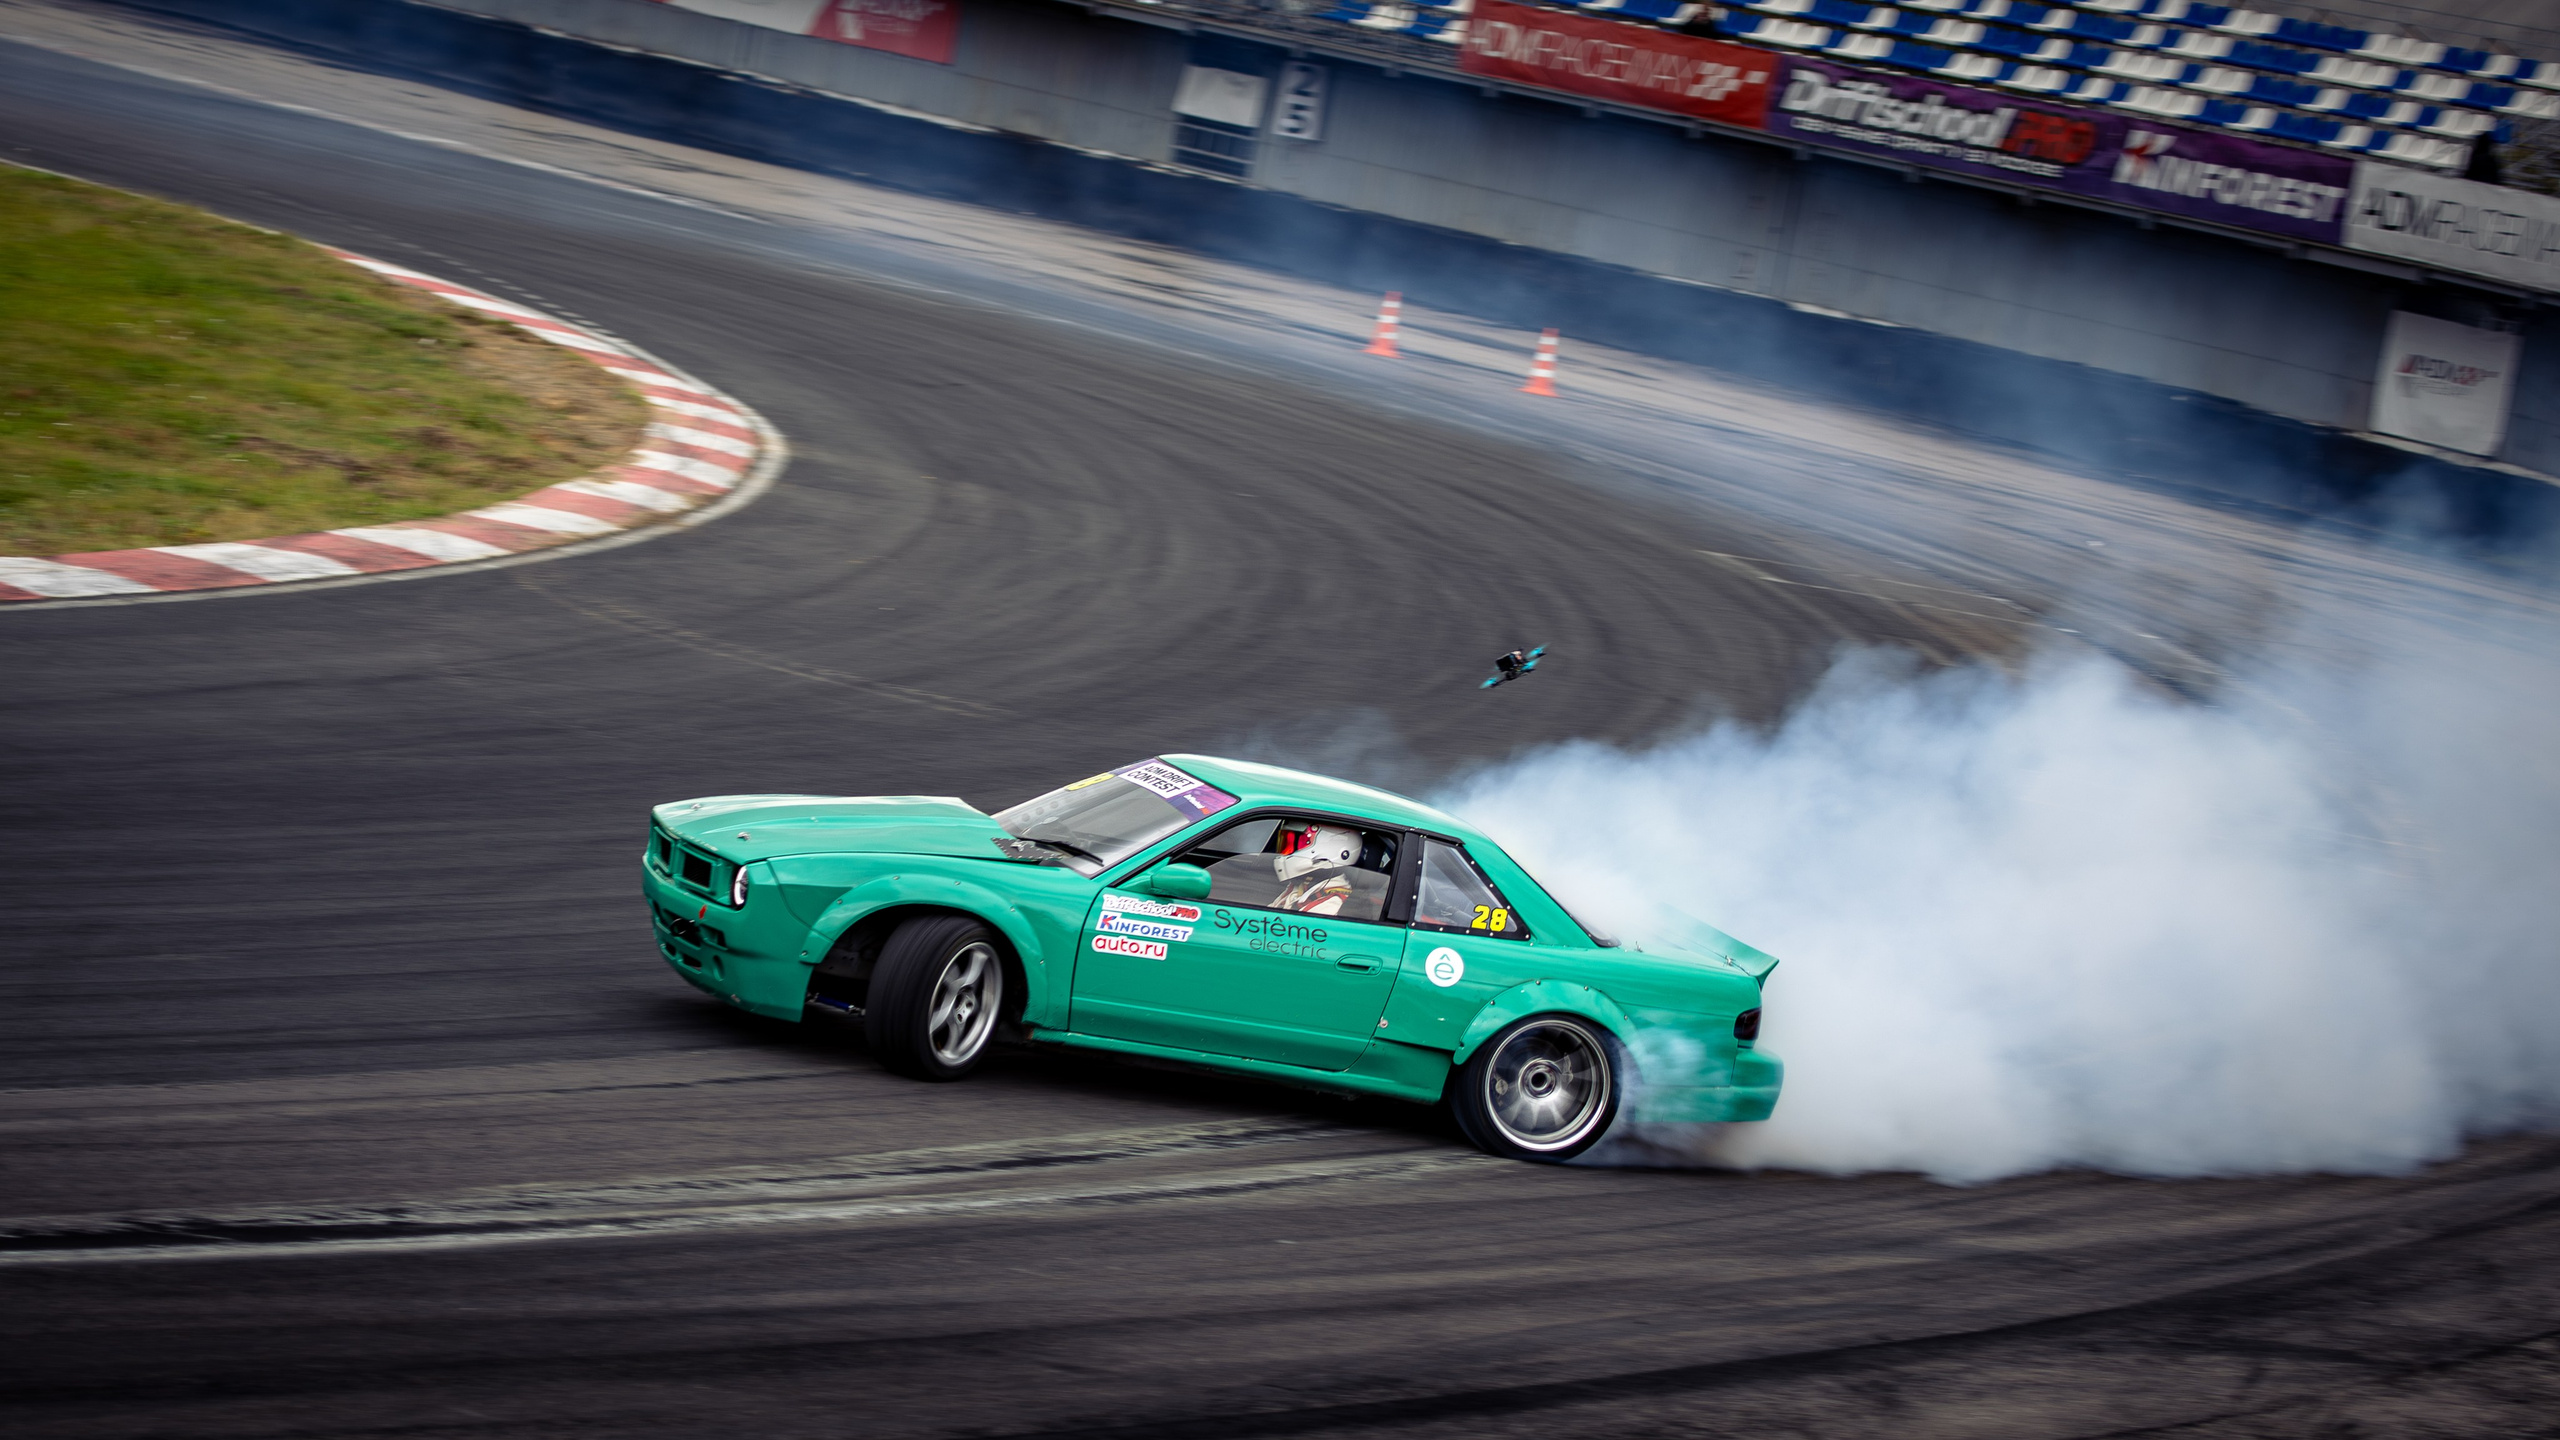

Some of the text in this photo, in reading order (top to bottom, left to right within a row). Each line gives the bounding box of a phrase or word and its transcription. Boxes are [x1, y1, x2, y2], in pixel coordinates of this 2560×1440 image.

[1127, 770, 1181, 793] CONTEST
[1162, 770, 1195, 787] DRIFT
[1100, 914, 1190, 940] KINFOREST
[1213, 908, 1328, 943] Système
[1471, 903, 1509, 932] 28
[1095, 937, 1165, 957] auto.ru
[1249, 935, 1327, 960] electric
